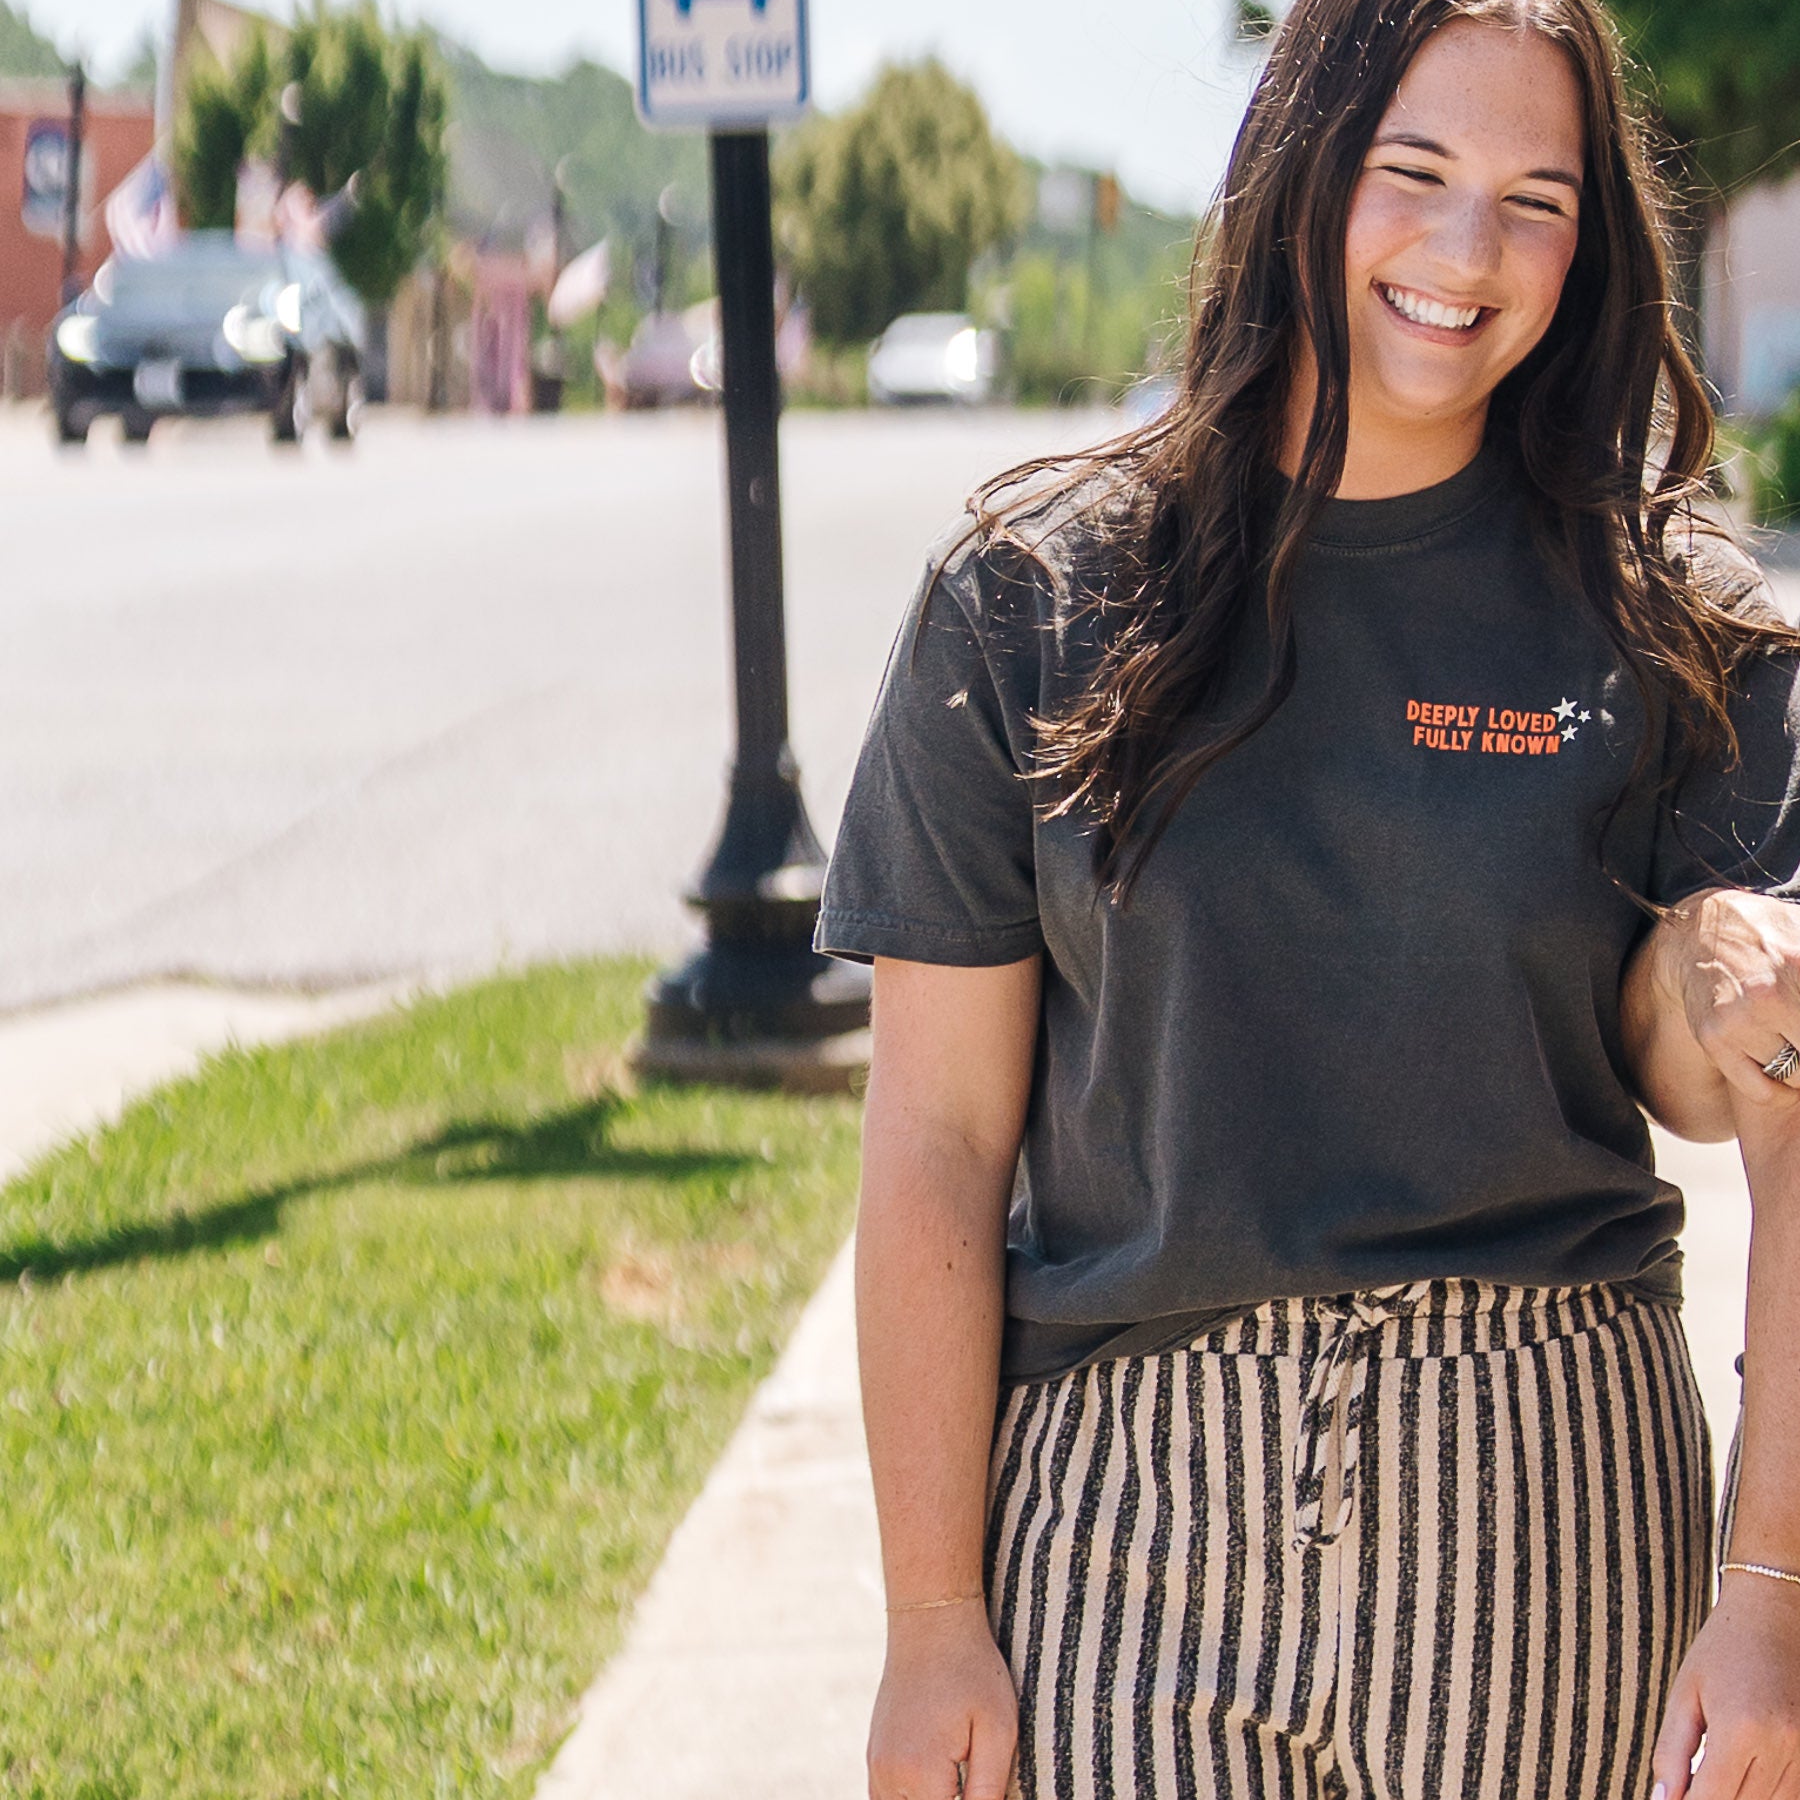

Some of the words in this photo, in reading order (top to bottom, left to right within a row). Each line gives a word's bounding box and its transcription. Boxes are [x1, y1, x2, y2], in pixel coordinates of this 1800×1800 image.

[648, 44, 704, 82] BUS
[724, 41, 792, 80] STOP
[1406, 700, 1480, 727] DEEPLY
[1488, 707, 1556, 733] LOVED
[1413, 725, 1473, 751] FULLY
[1481, 732, 1560, 755] KNOWN
